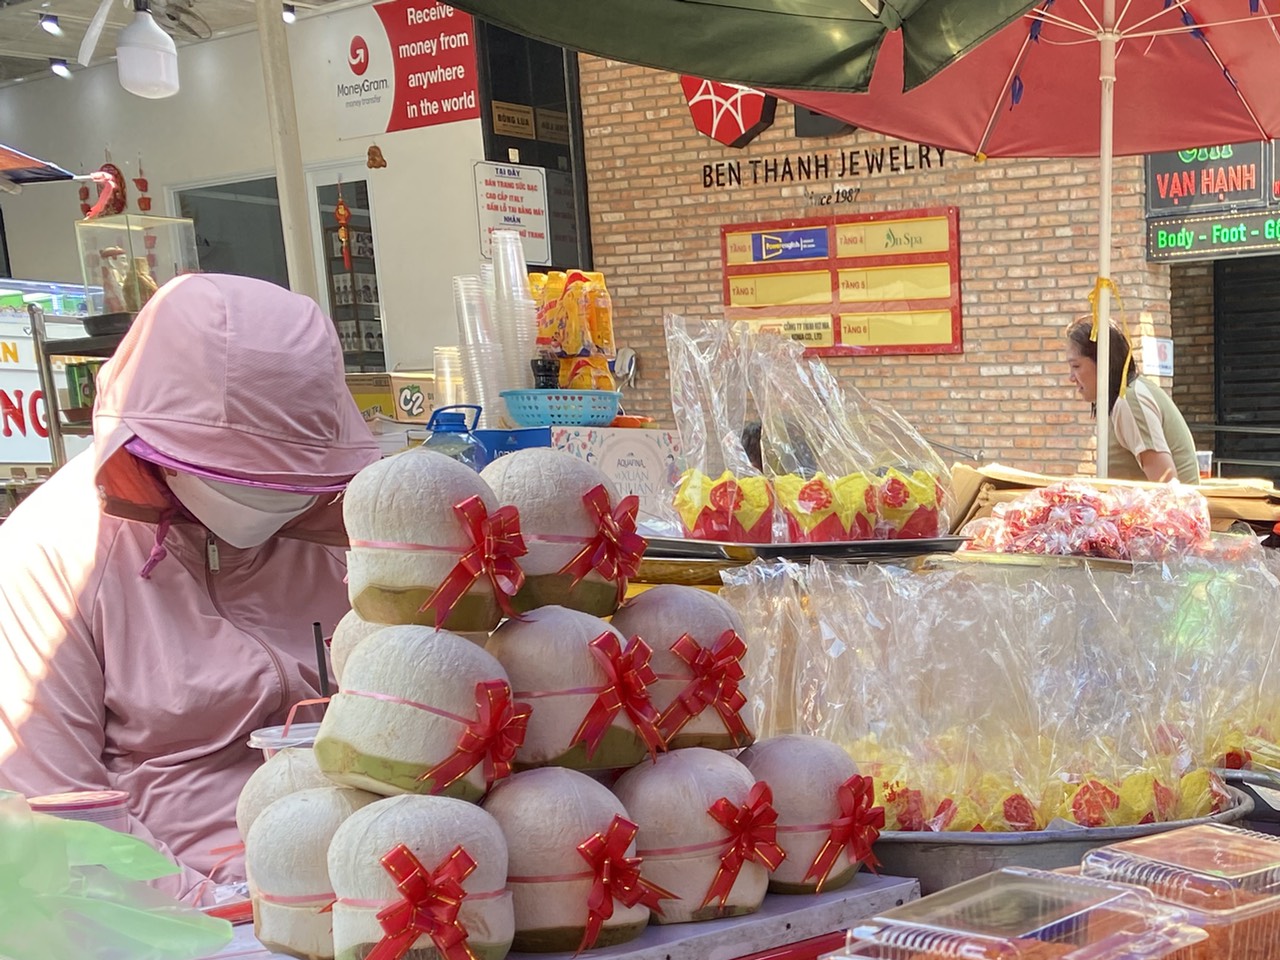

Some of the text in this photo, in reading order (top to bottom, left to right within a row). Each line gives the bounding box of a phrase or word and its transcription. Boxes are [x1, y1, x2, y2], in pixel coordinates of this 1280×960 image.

[406, 2, 454, 26] Receive
[398, 32, 469, 59] money from
[337, 78, 388, 97] MoneyGram
[408, 65, 465, 89] anywhere
[406, 101, 418, 118] in
[420, 98, 439, 116] the
[441, 90, 476, 112] world
[703, 145, 945, 188] BEN THANH JEWELRY
[497, 181, 514, 189] TRANG
[1157, 163, 1256, 205] VẠN HẠNH
[804, 188, 861, 206] ince 1987
[904, 233, 922, 248] Spa
[1158, 227, 1194, 249] Body
[1212, 222, 1246, 244] Foot
[0, 342, 19, 362] N
[399, 387, 426, 416] C2
[617, 459, 646, 468] AQUAFINA
